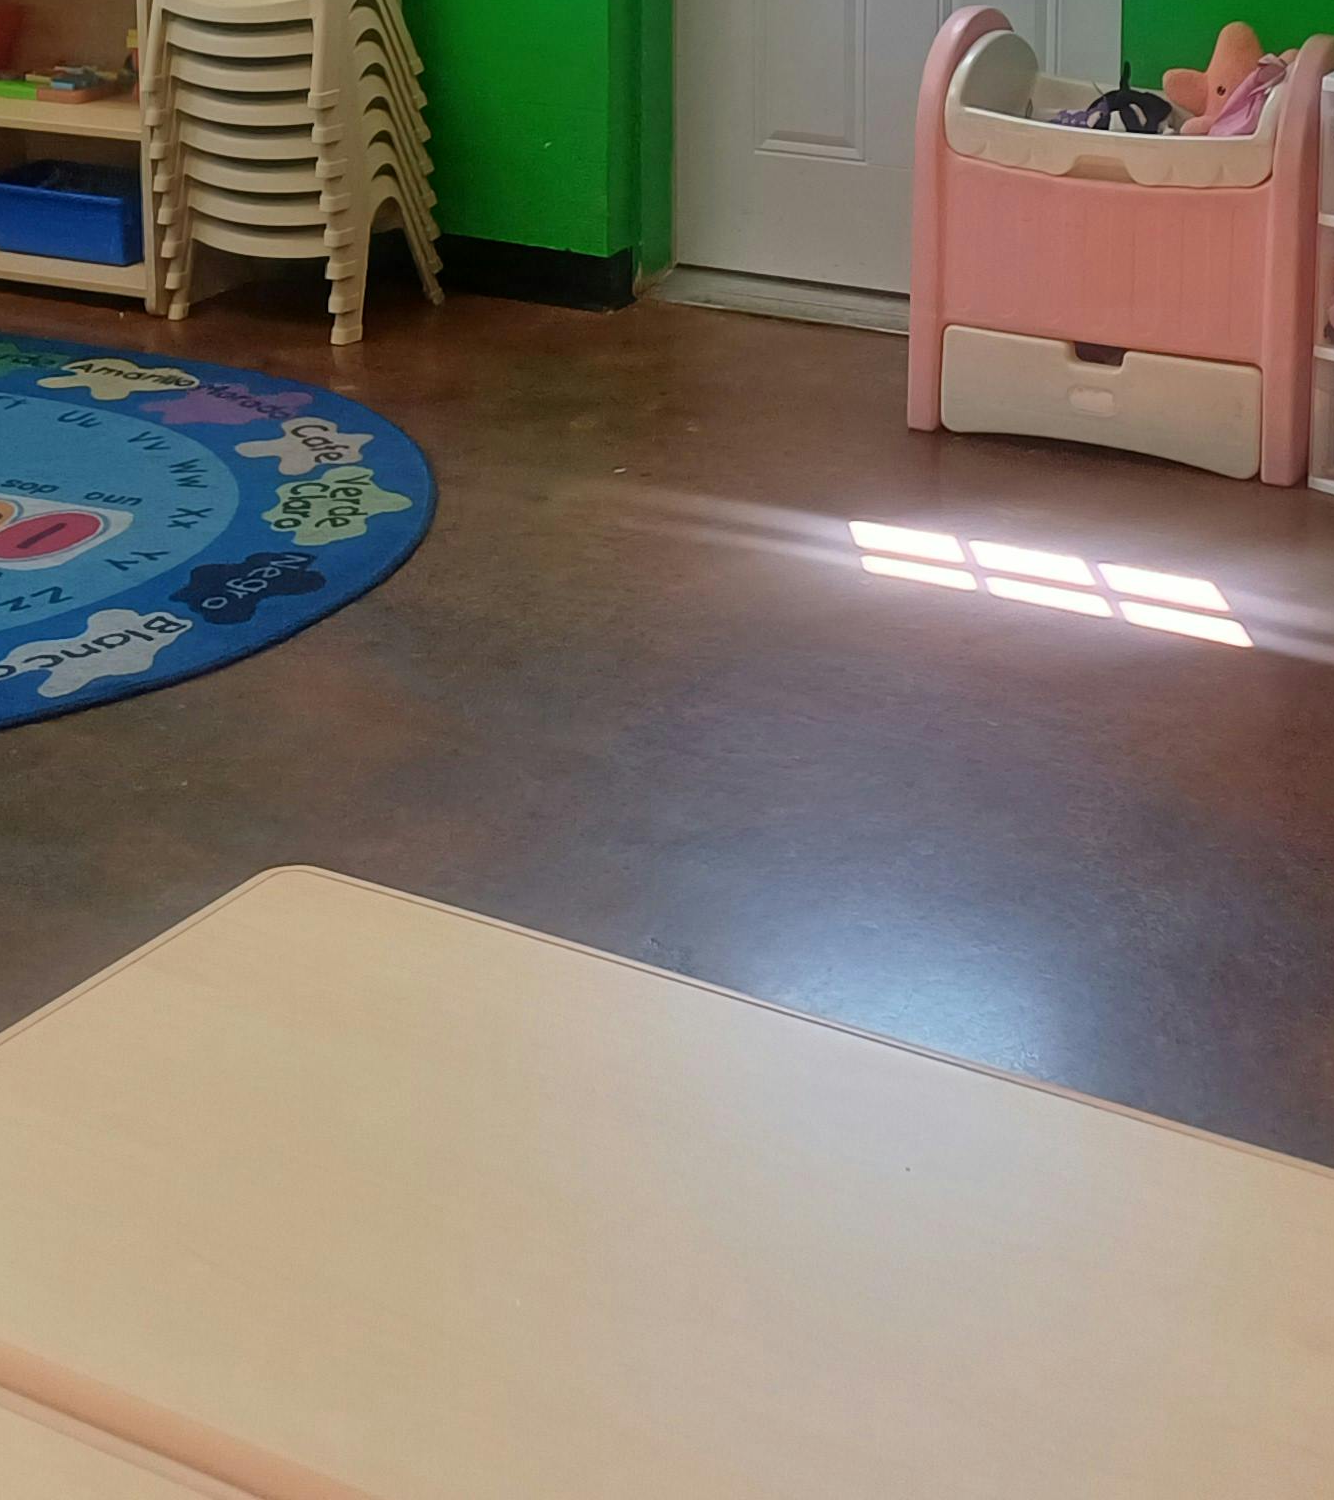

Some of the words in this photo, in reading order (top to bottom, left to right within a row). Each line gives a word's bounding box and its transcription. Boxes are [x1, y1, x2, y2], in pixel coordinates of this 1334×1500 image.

[128, 431, 171, 451] Vv
[0, 478, 61, 494] dos
[82, 491, 145, 508] uno
[273, 482, 331, 530] Claro
[315, 474, 370, 528] Verde
[168, 507, 214, 529] Xx
[17, 521, 67, 549] 1
[202, 552, 310, 609] Negro
